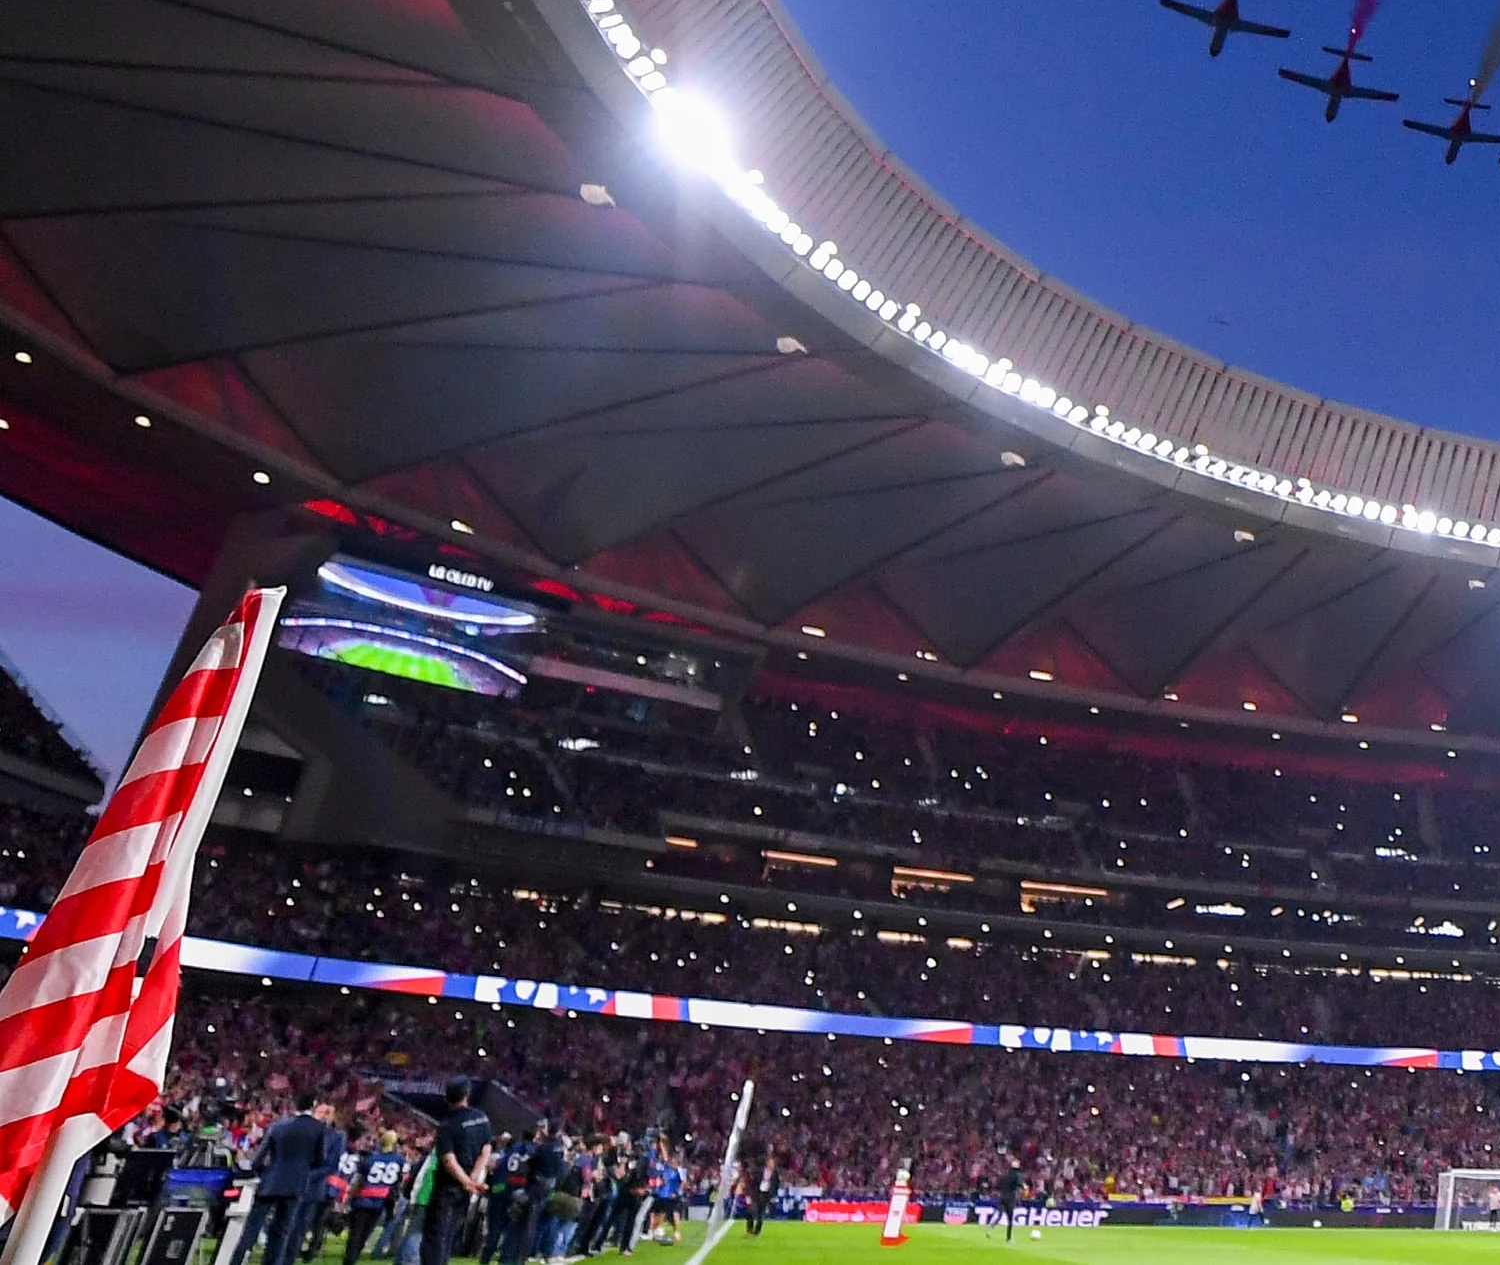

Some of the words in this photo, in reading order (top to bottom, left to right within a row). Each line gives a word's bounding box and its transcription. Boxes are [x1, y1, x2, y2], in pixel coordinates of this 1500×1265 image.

[428, 564, 446, 580] LG
[446, 569, 477, 587] OLED
[477, 577, 494, 591] TV
[367, 1161, 401, 1185] 58
